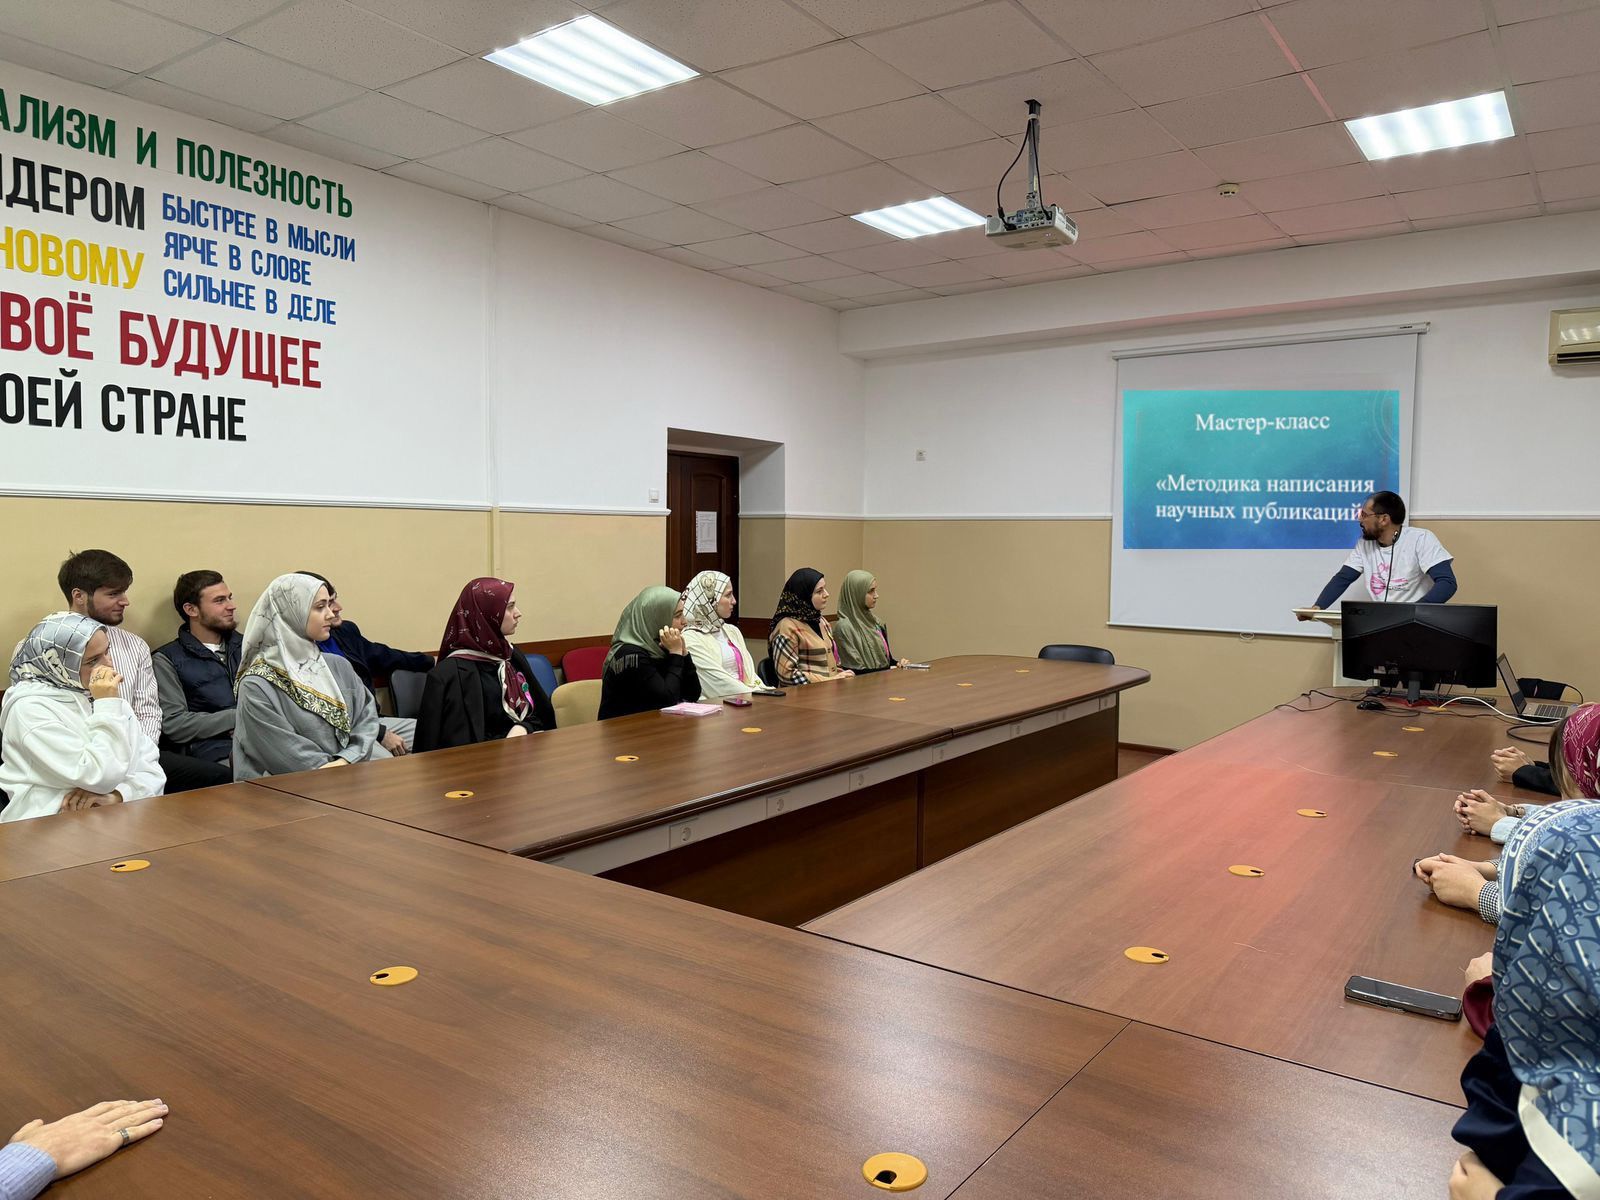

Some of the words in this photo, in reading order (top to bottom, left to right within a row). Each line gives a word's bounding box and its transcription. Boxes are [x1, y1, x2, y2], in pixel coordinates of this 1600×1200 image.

[0, 153, 145, 231] ДЕРОМ
[137, 127, 157, 168] И
[177, 137, 353, 218] ПОЛЕЗНОСТЬ
[162, 193, 256, 240] БЫСТРЕЕ
[266, 218, 278, 244] В
[288, 223, 355, 262] МЫСЛИ
[163, 231, 218, 267] ЯРЧЕ
[229, 244, 241, 271] В
[251, 250, 312, 286] СЛОВЕ
[163, 269, 256, 311] СИЛЬНЕЕ
[265, 289, 278, 314] В
[288, 294, 337, 325] ДЕЛЕ
[0, 291, 94, 360] ВОЁ
[120, 310, 321, 389] БУДУЩЕЕ
[0, 367, 82, 429] ОЕЙ
[101, 384, 247, 442] СТРАНЕ
[1195, 413, 1330, 434] Мастер-класс
[1156, 474, 1260, 494] «Методика
[1267, 478, 1375, 493] написания
[1156, 503, 1236, 522] научных
[1242, 502, 1362, 522] публикаций
